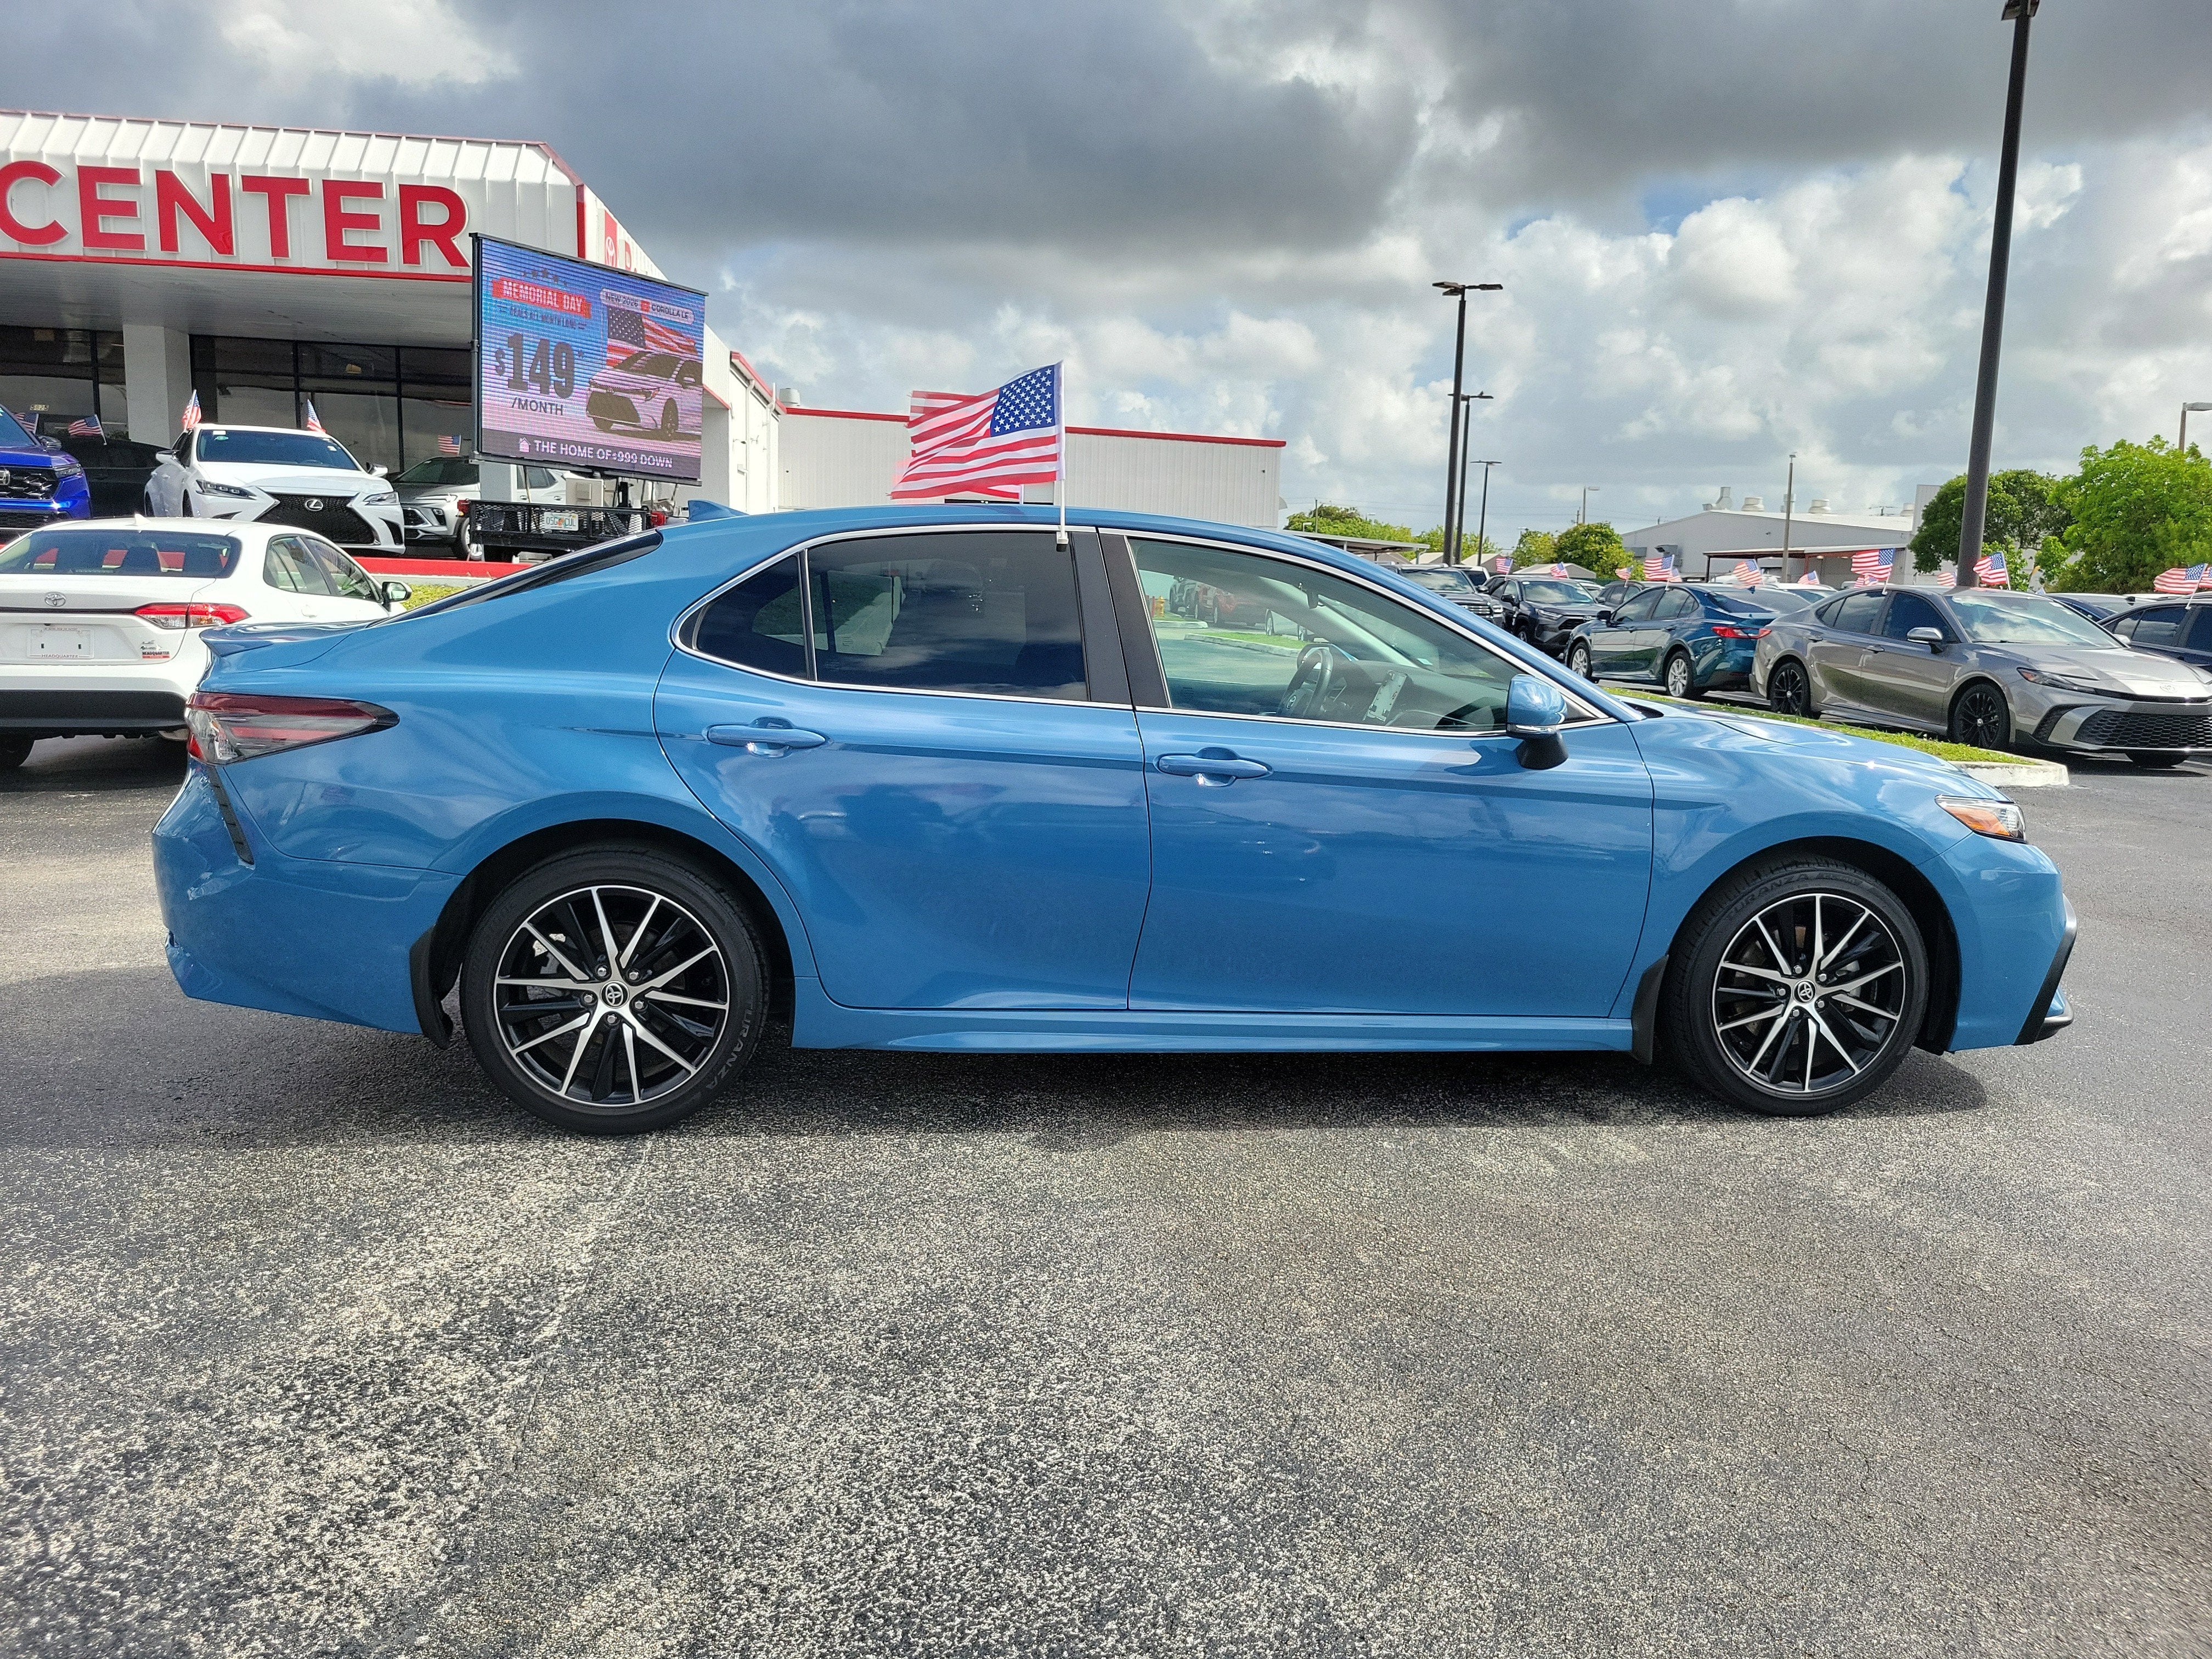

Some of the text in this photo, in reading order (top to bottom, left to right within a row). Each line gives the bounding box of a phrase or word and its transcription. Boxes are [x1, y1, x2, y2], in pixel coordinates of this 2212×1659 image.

[0, 160, 471, 268] CENTER
[503, 280, 583, 313] MEMORIAL DAY
[651, 303, 680, 318] COROLLA
[534, 440, 557, 454] THE
[560, 443, 594, 459] HOME
[596, 448, 612, 460] OF
[641, 454, 673, 469] DOWN
